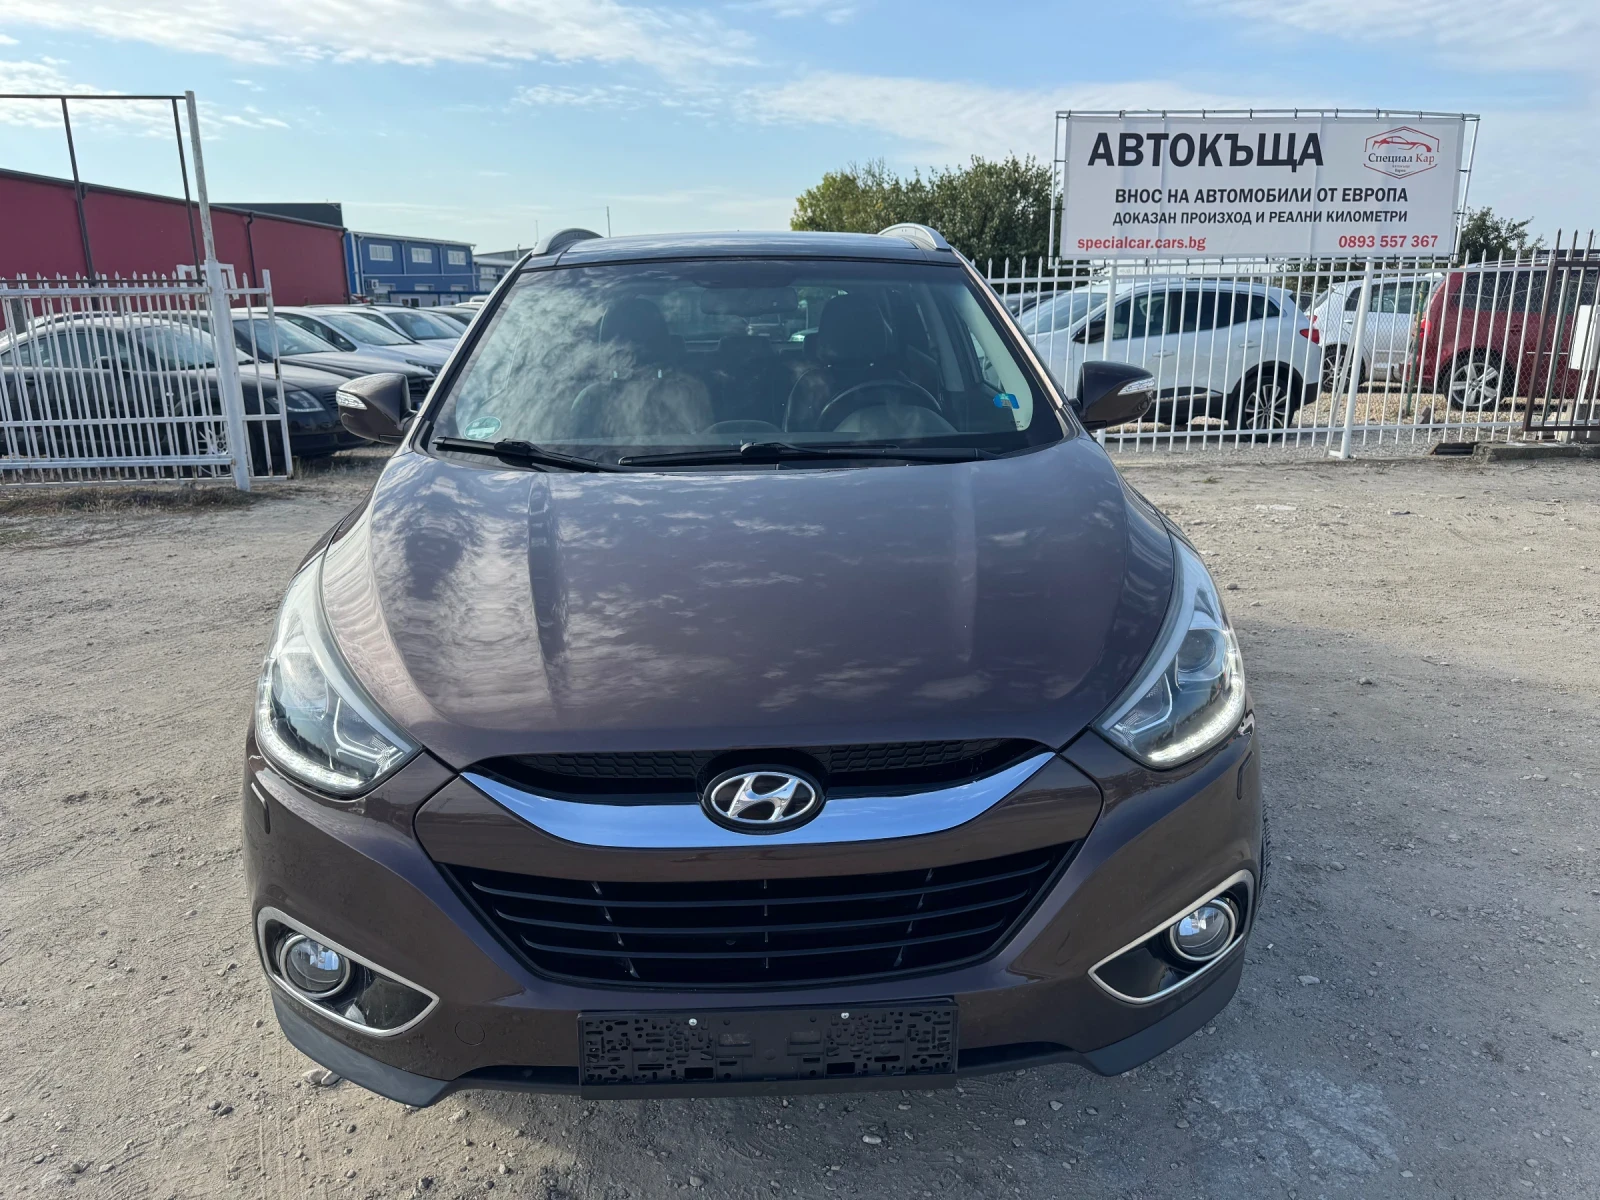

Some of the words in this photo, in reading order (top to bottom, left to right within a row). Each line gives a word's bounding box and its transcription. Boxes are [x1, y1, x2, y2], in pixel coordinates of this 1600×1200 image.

[1087, 132, 1323, 173] АВТОКЪЩА
[1368, 152, 1412, 164] Специал
[1415, 154, 1435, 166] Кар
[1114, 188, 1162, 203] ВНОС
[1167, 188, 1189, 203] НА
[1193, 187, 1311, 203] АВТОМОБИЛИ
[1316, 187, 1337, 202] ОТ
[1341, 187, 1408, 202] ЕВРОПА
[1112, 211, 1176, 226] ДОКАЗАН
[1180, 211, 1252, 225] ПРОИЗХОД
[1255, 211, 1264, 223] И
[1268, 210, 1322, 222] РЕАЛНИ
[1325, 210, 1407, 222] КИЛОМЕТРИ
[1077, 236, 1206, 251] specialcar.cars.bg
[1338, 236, 1375, 248] 0893
[1379, 235, 1407, 247] 557
[1411, 235, 1438, 247] 367
